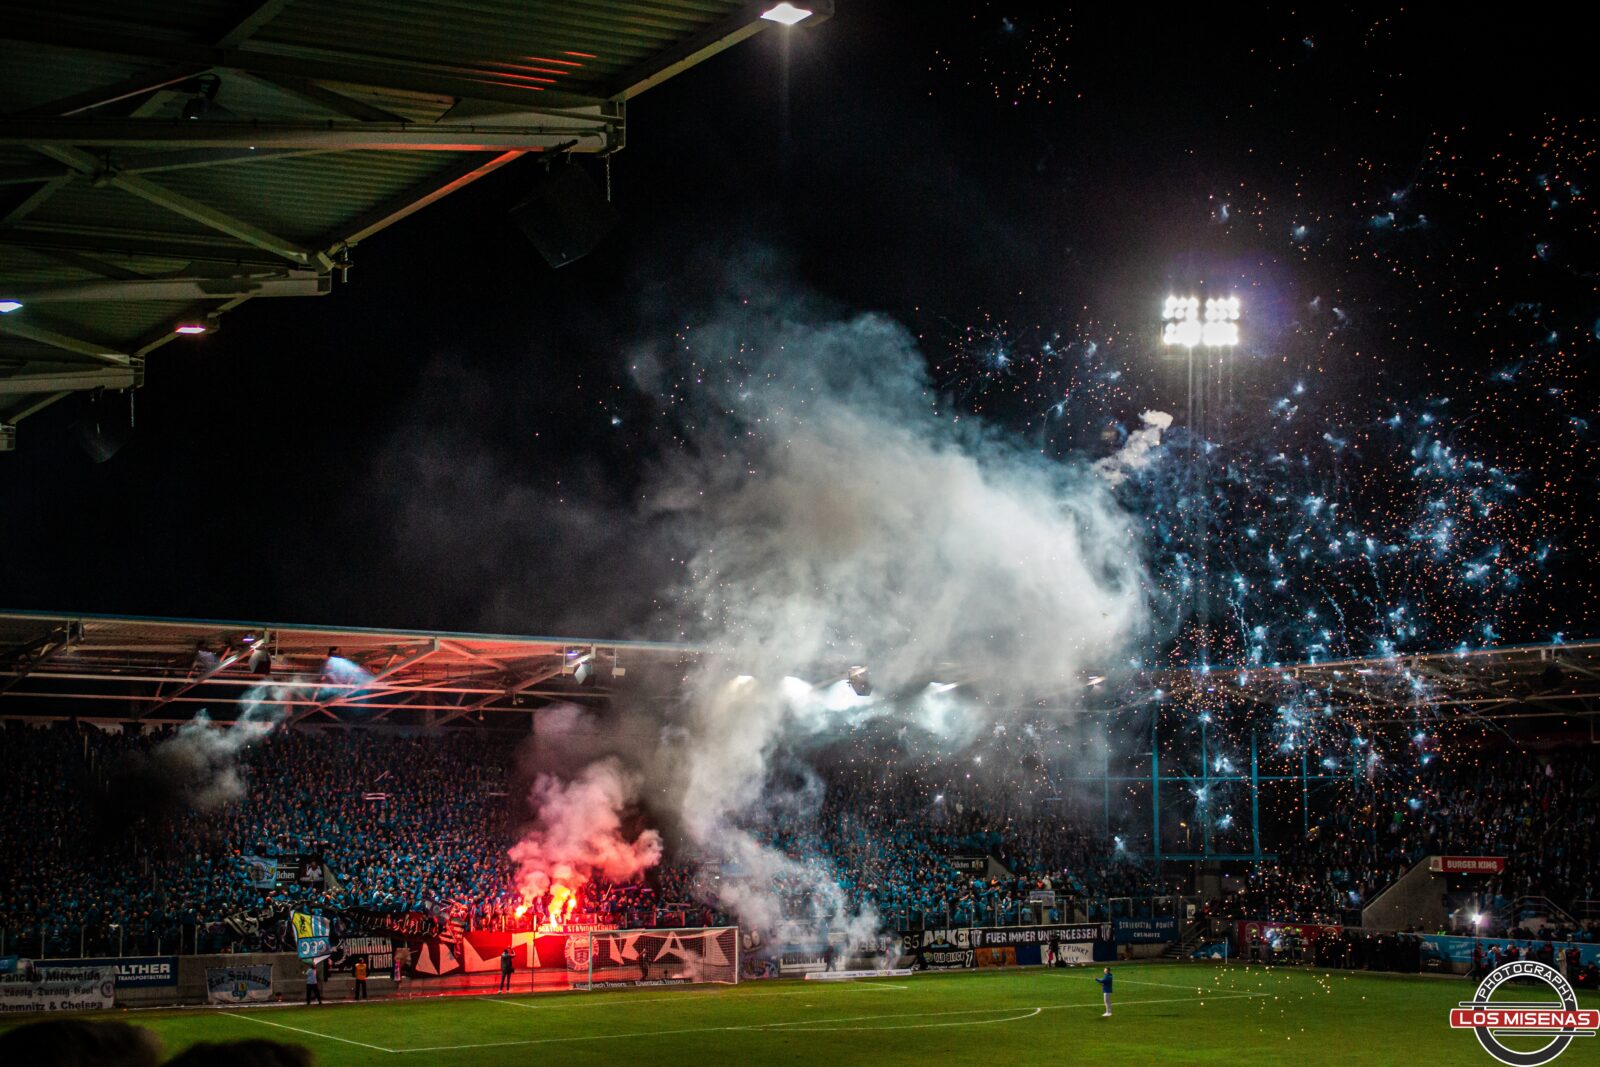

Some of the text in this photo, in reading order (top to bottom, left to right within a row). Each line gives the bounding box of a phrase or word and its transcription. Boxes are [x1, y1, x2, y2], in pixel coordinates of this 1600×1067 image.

[1447, 859, 1498, 869] BURGER KING
[985, 931, 1007, 943] FUER
[1008, 930, 1036, 942] IMMER
[903, 935, 920, 950] 85
[49, 1001, 57, 1010] &
